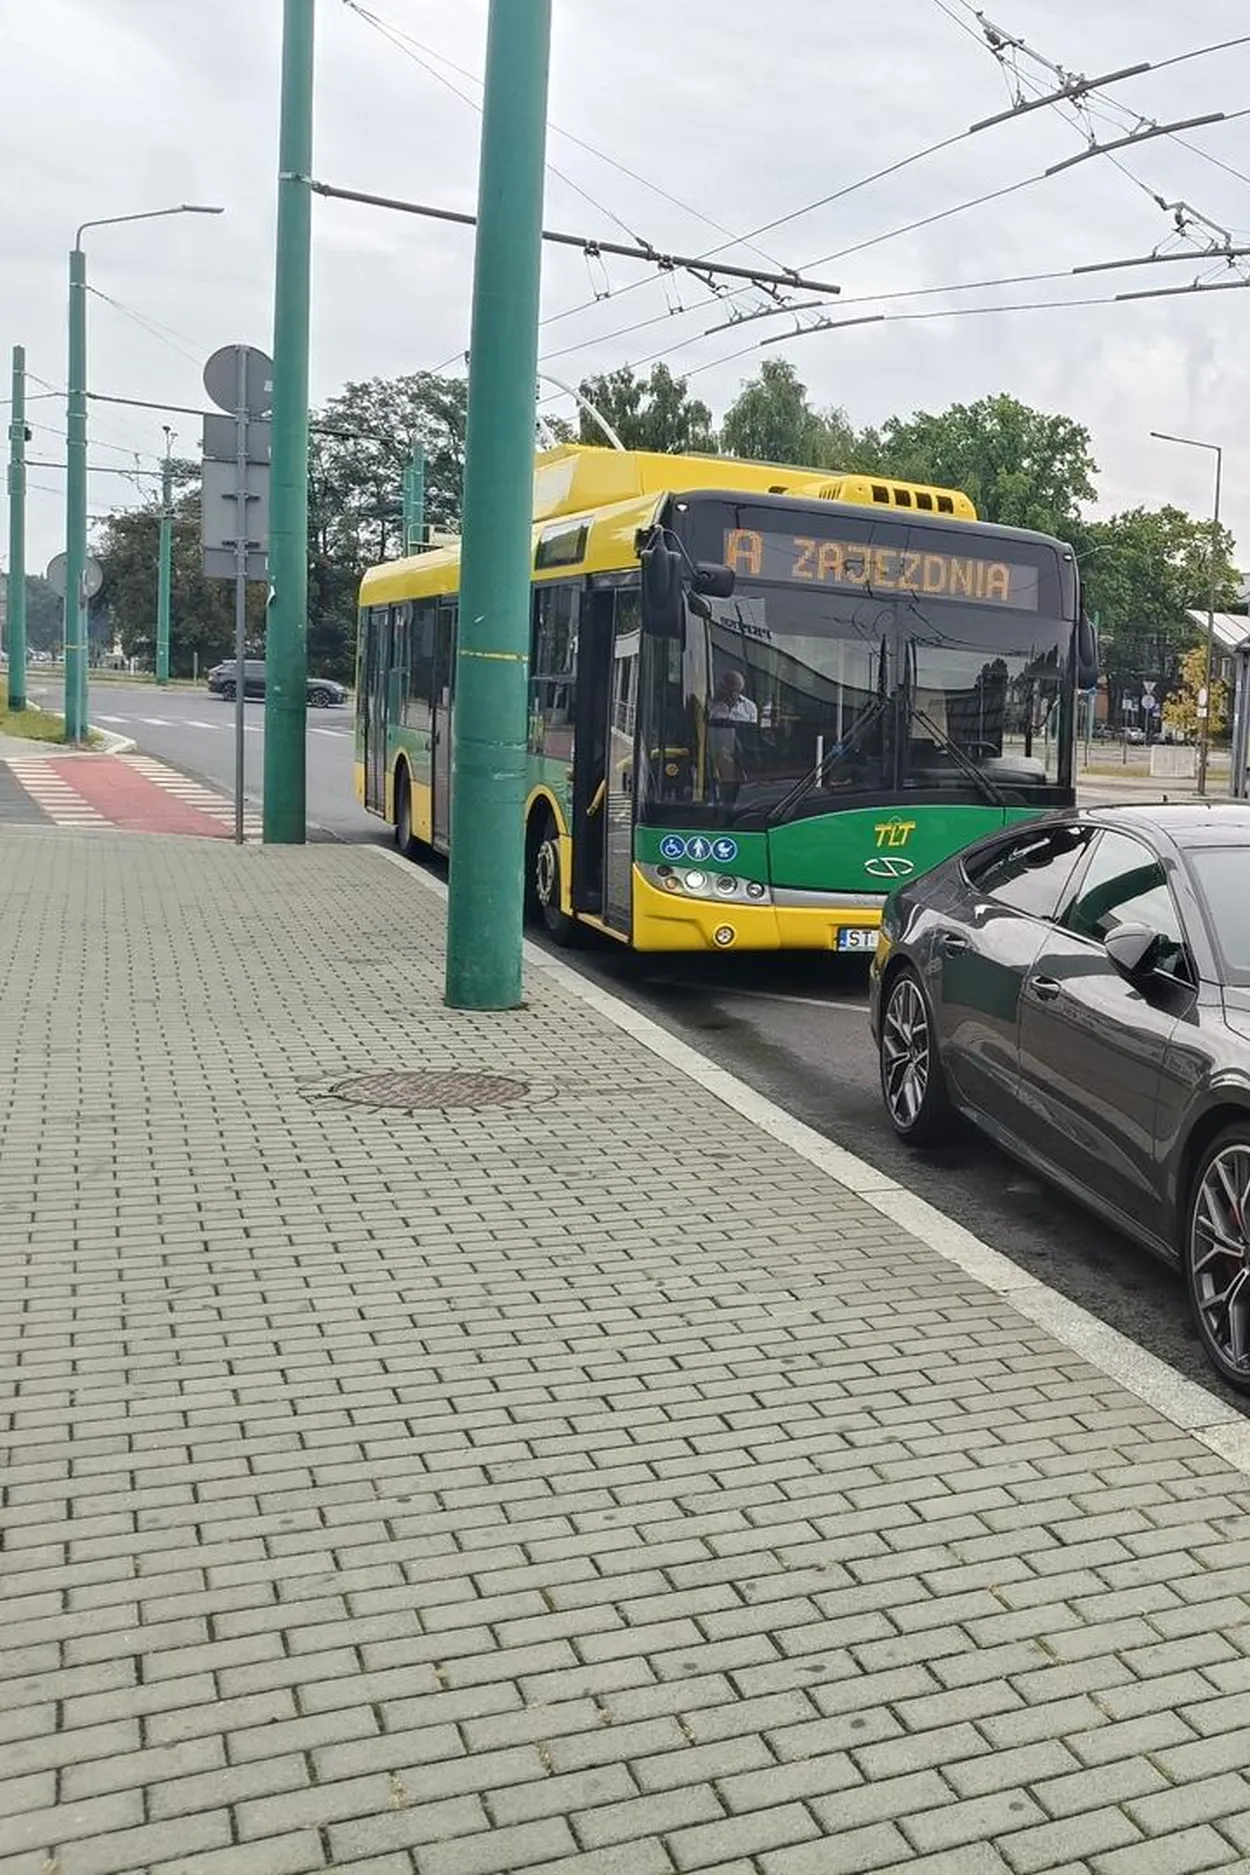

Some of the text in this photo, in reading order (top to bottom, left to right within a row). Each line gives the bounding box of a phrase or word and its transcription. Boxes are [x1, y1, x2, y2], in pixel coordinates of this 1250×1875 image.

[726, 528, 1012, 600] A ZAJEZDNIA
[875, 820, 916, 848] TLT
